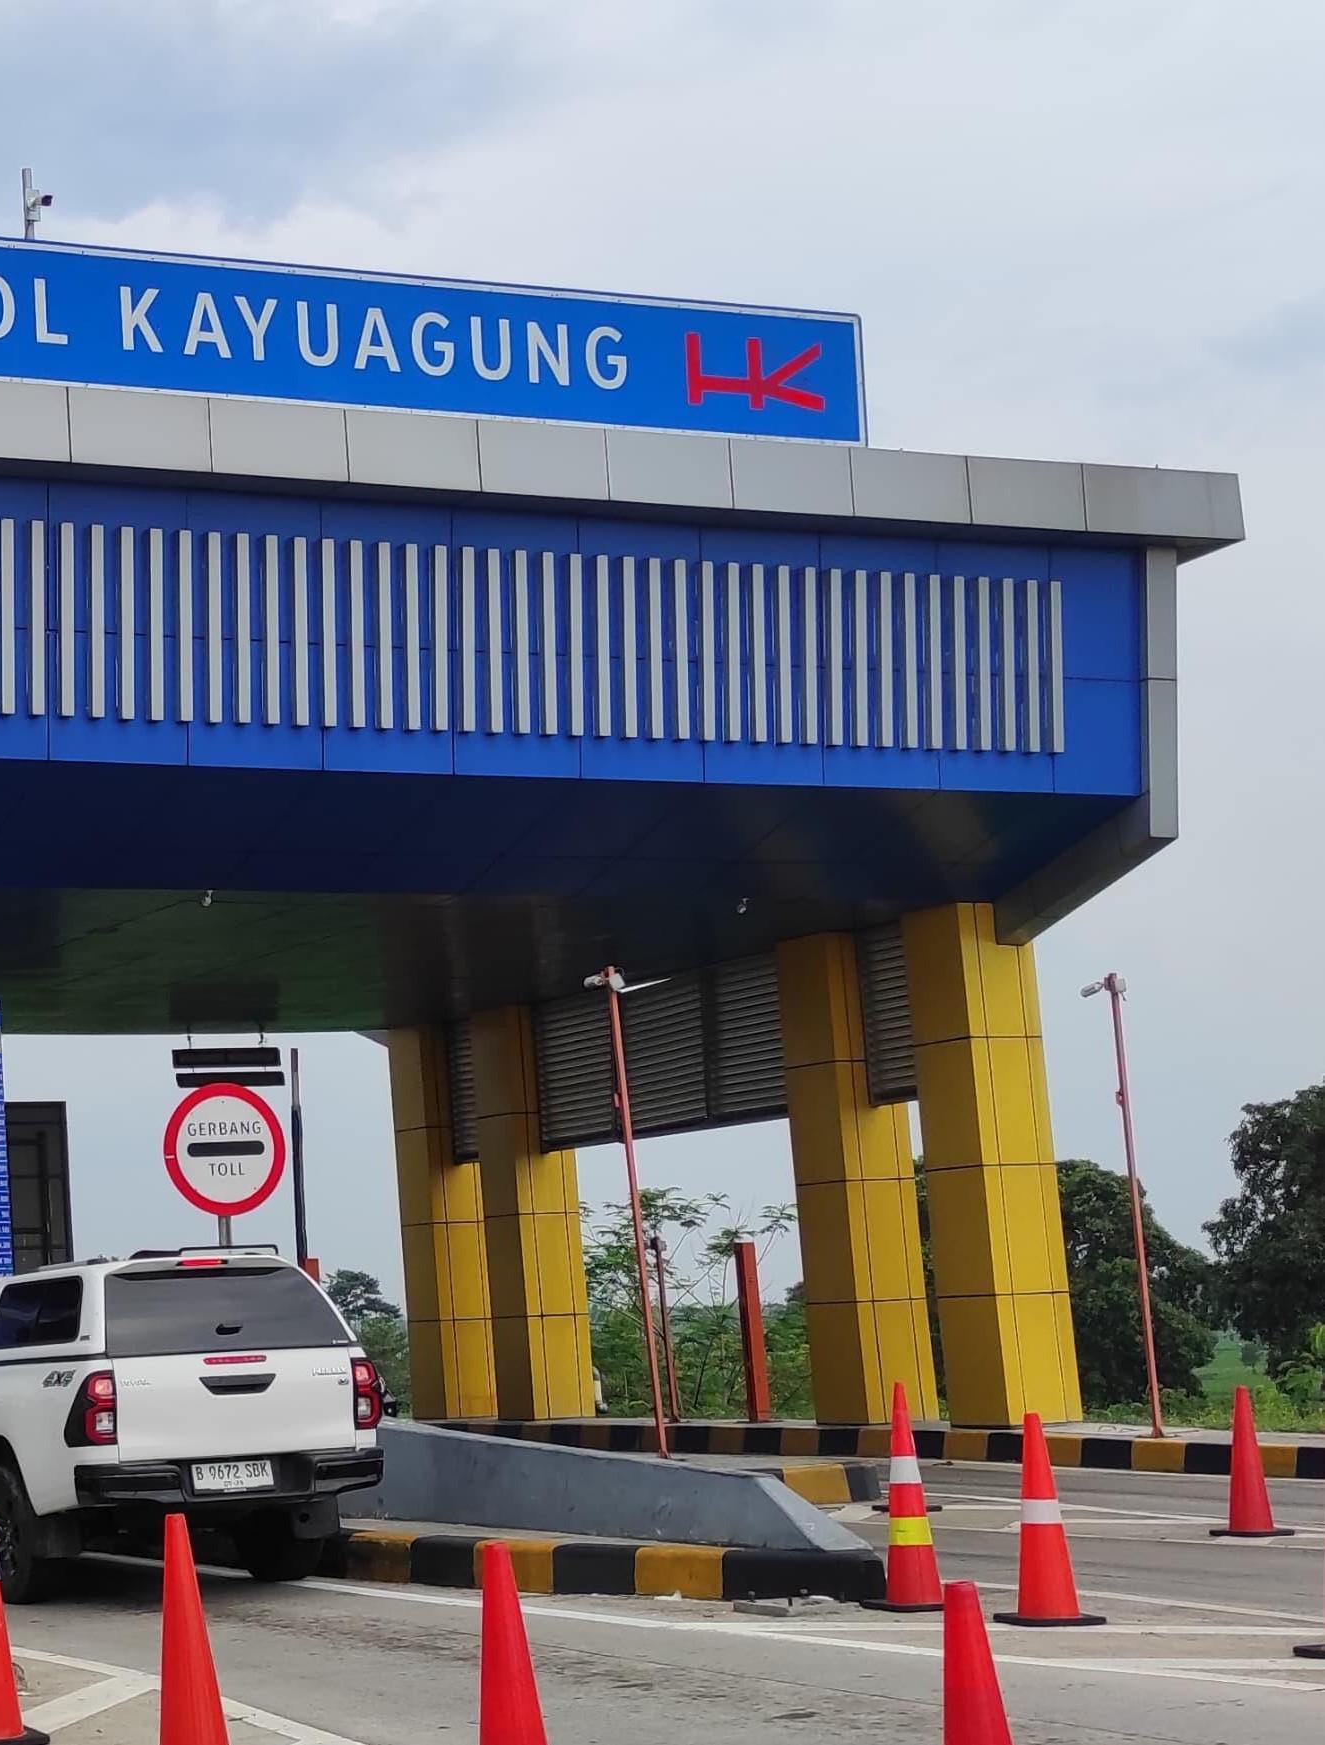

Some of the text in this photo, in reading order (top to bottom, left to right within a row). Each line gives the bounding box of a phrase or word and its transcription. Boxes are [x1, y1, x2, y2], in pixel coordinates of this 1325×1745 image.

[119, 285, 630, 391] KAYUAGUNG
[187, 1121, 261, 1137] GERBANG
[208, 1162, 245, 1177] TOLL
[195, 1461, 269, 1481] B 9672 SDK
